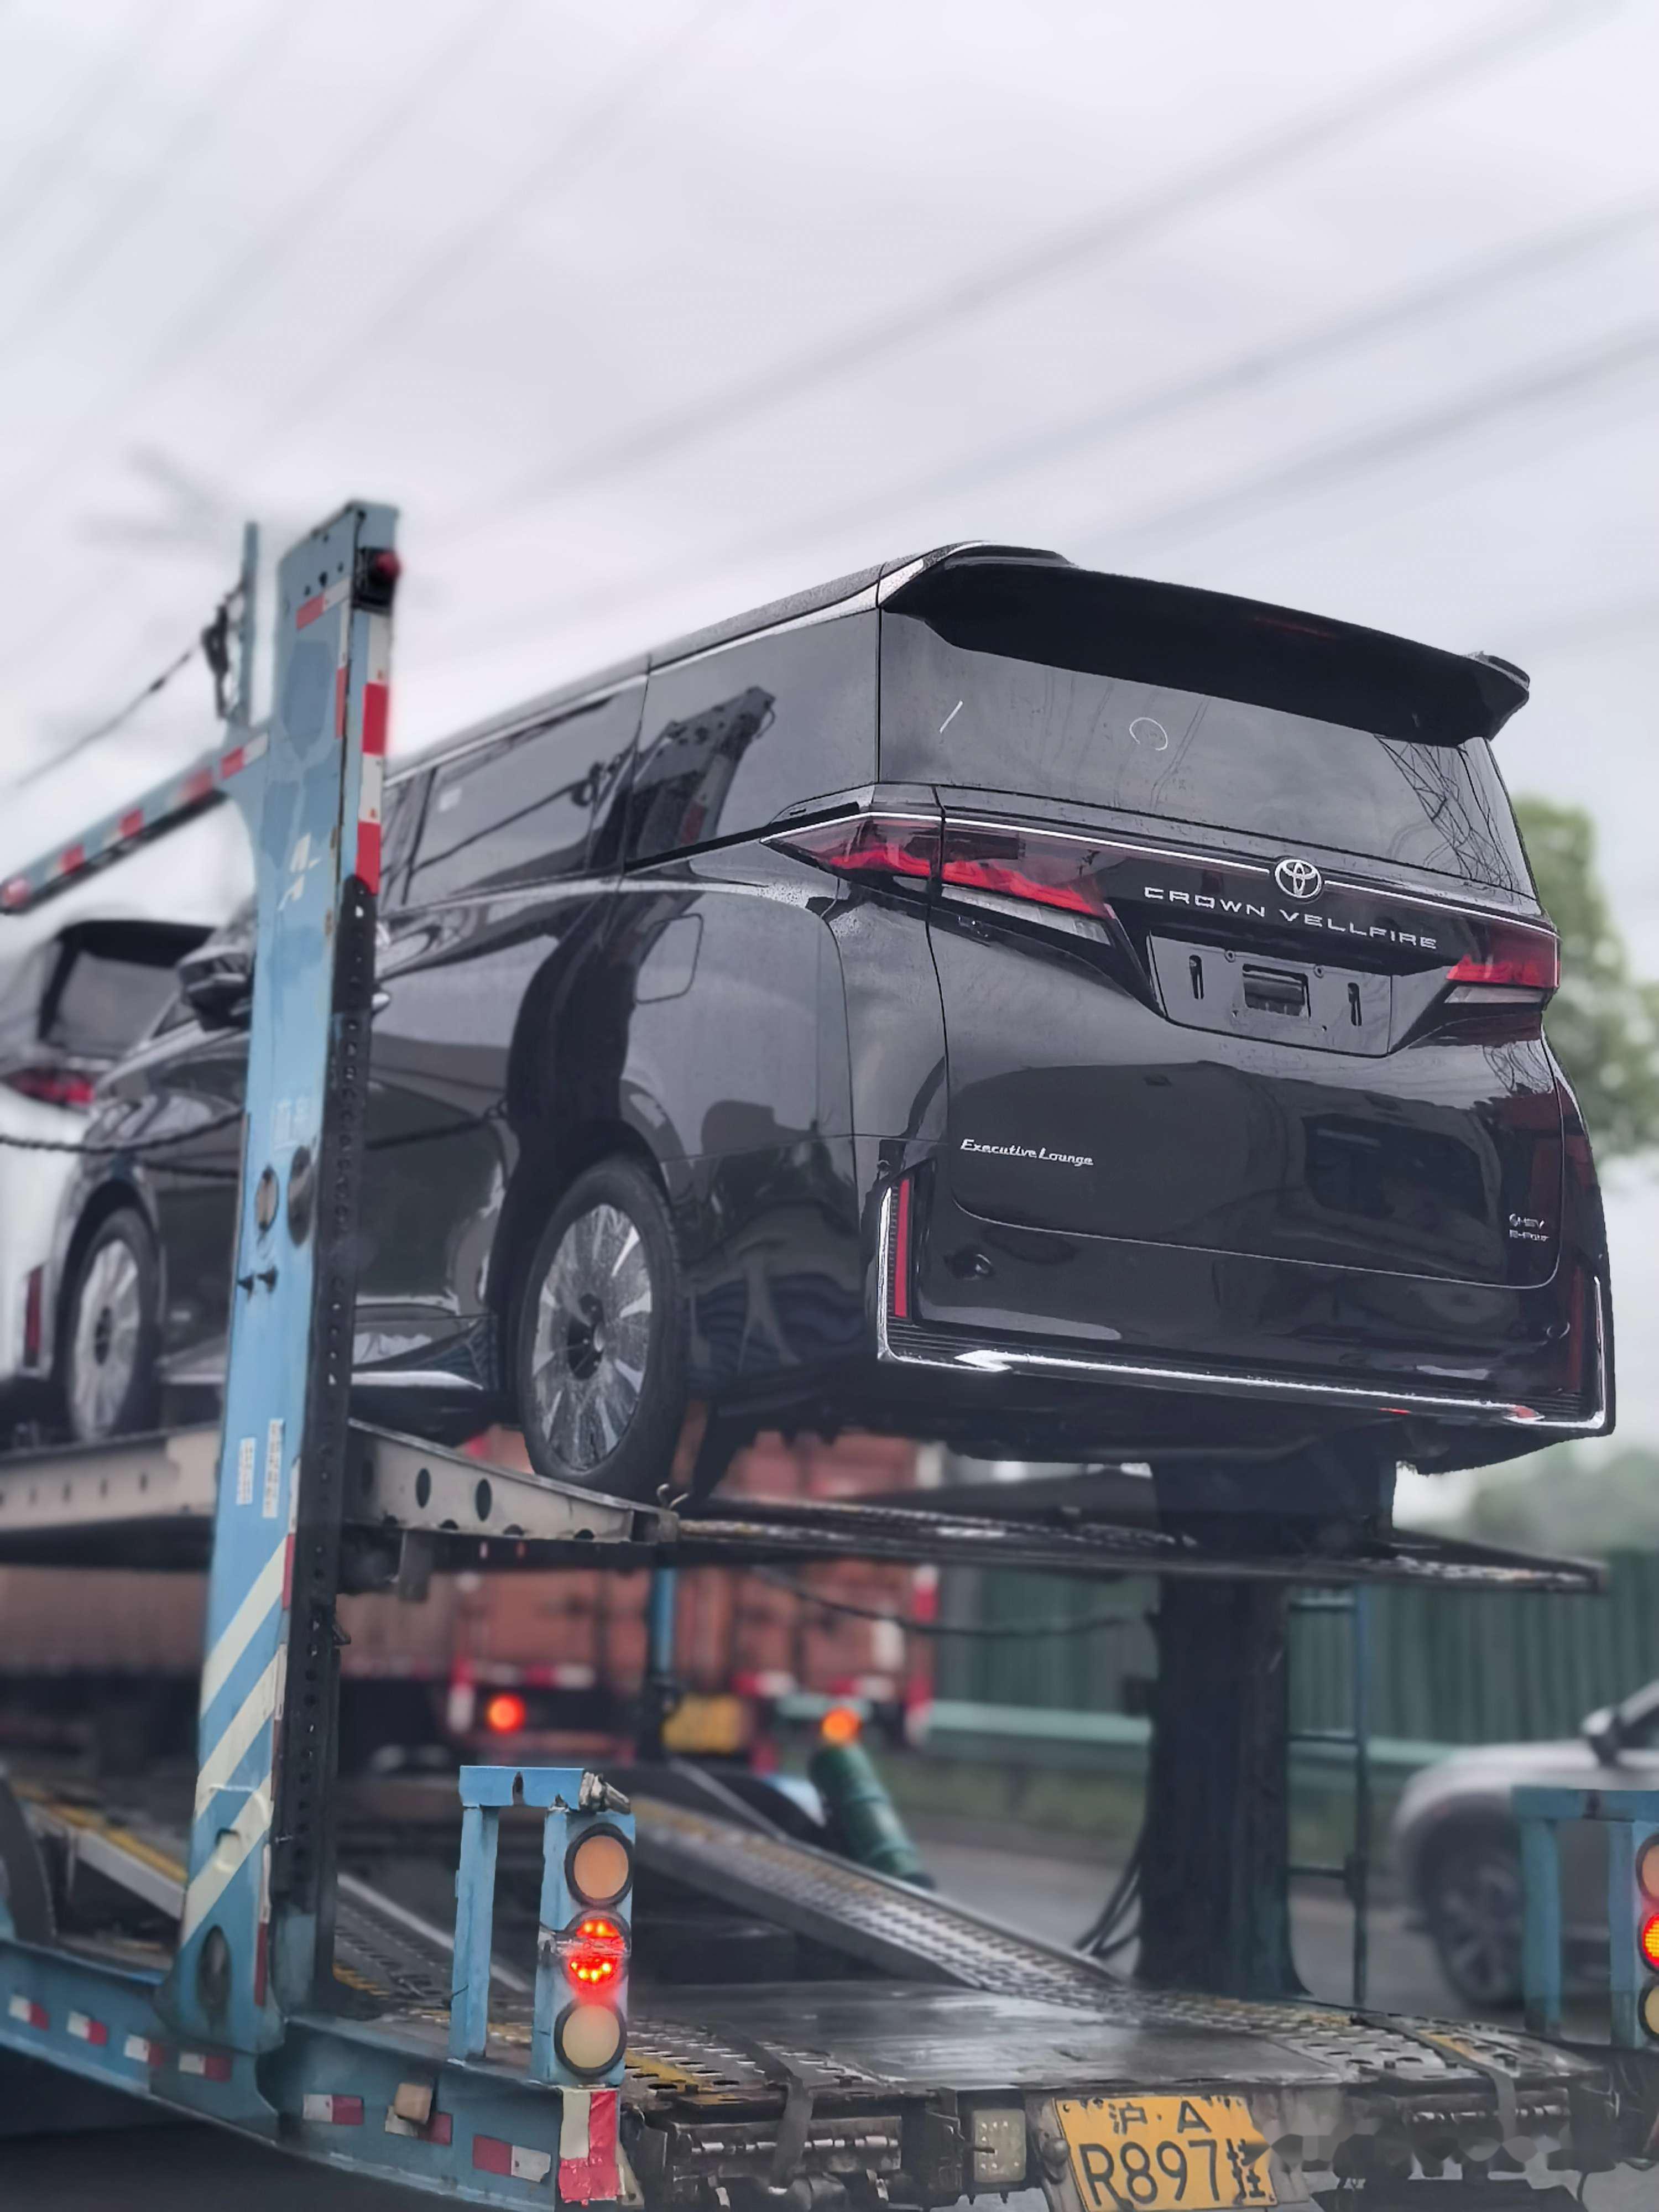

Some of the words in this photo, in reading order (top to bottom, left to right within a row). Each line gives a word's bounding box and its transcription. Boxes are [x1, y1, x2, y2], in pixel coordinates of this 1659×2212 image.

[1145, 887, 1265, 917] CROWN
[1279, 909, 1438, 950] VELLFIRE
[960, 1138, 1037, 1158] Executive
[1039, 1147, 1094, 1167] Lounge
